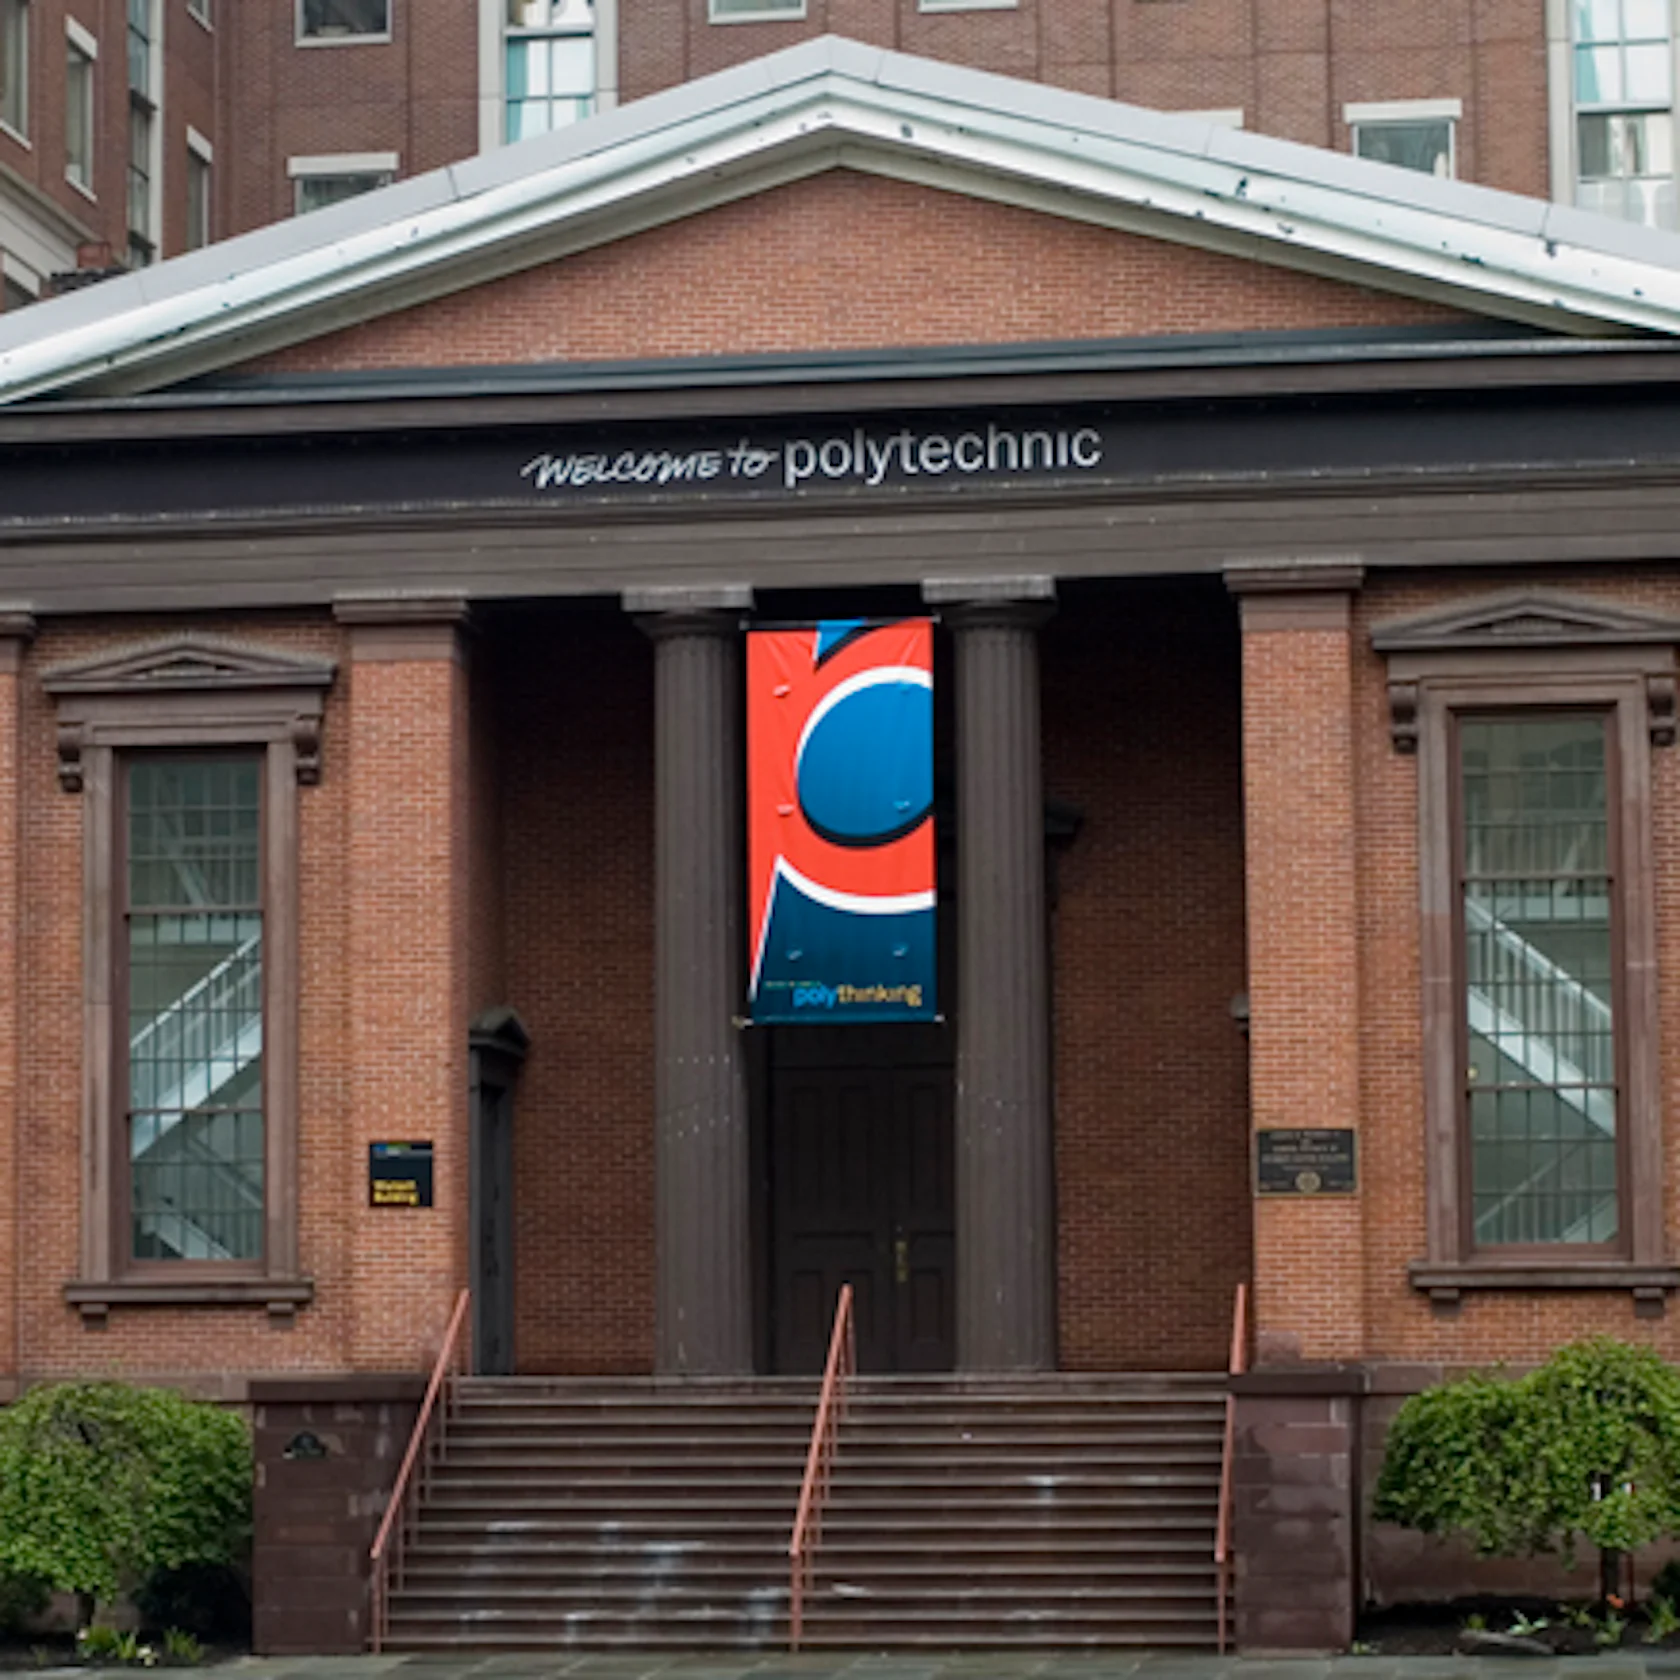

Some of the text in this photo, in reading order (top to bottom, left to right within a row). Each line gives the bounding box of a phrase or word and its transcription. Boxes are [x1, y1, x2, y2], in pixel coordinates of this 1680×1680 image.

[519, 422, 1102, 489] WELCOME to polytechnic
[792, 983, 923, 1009] polythinking
